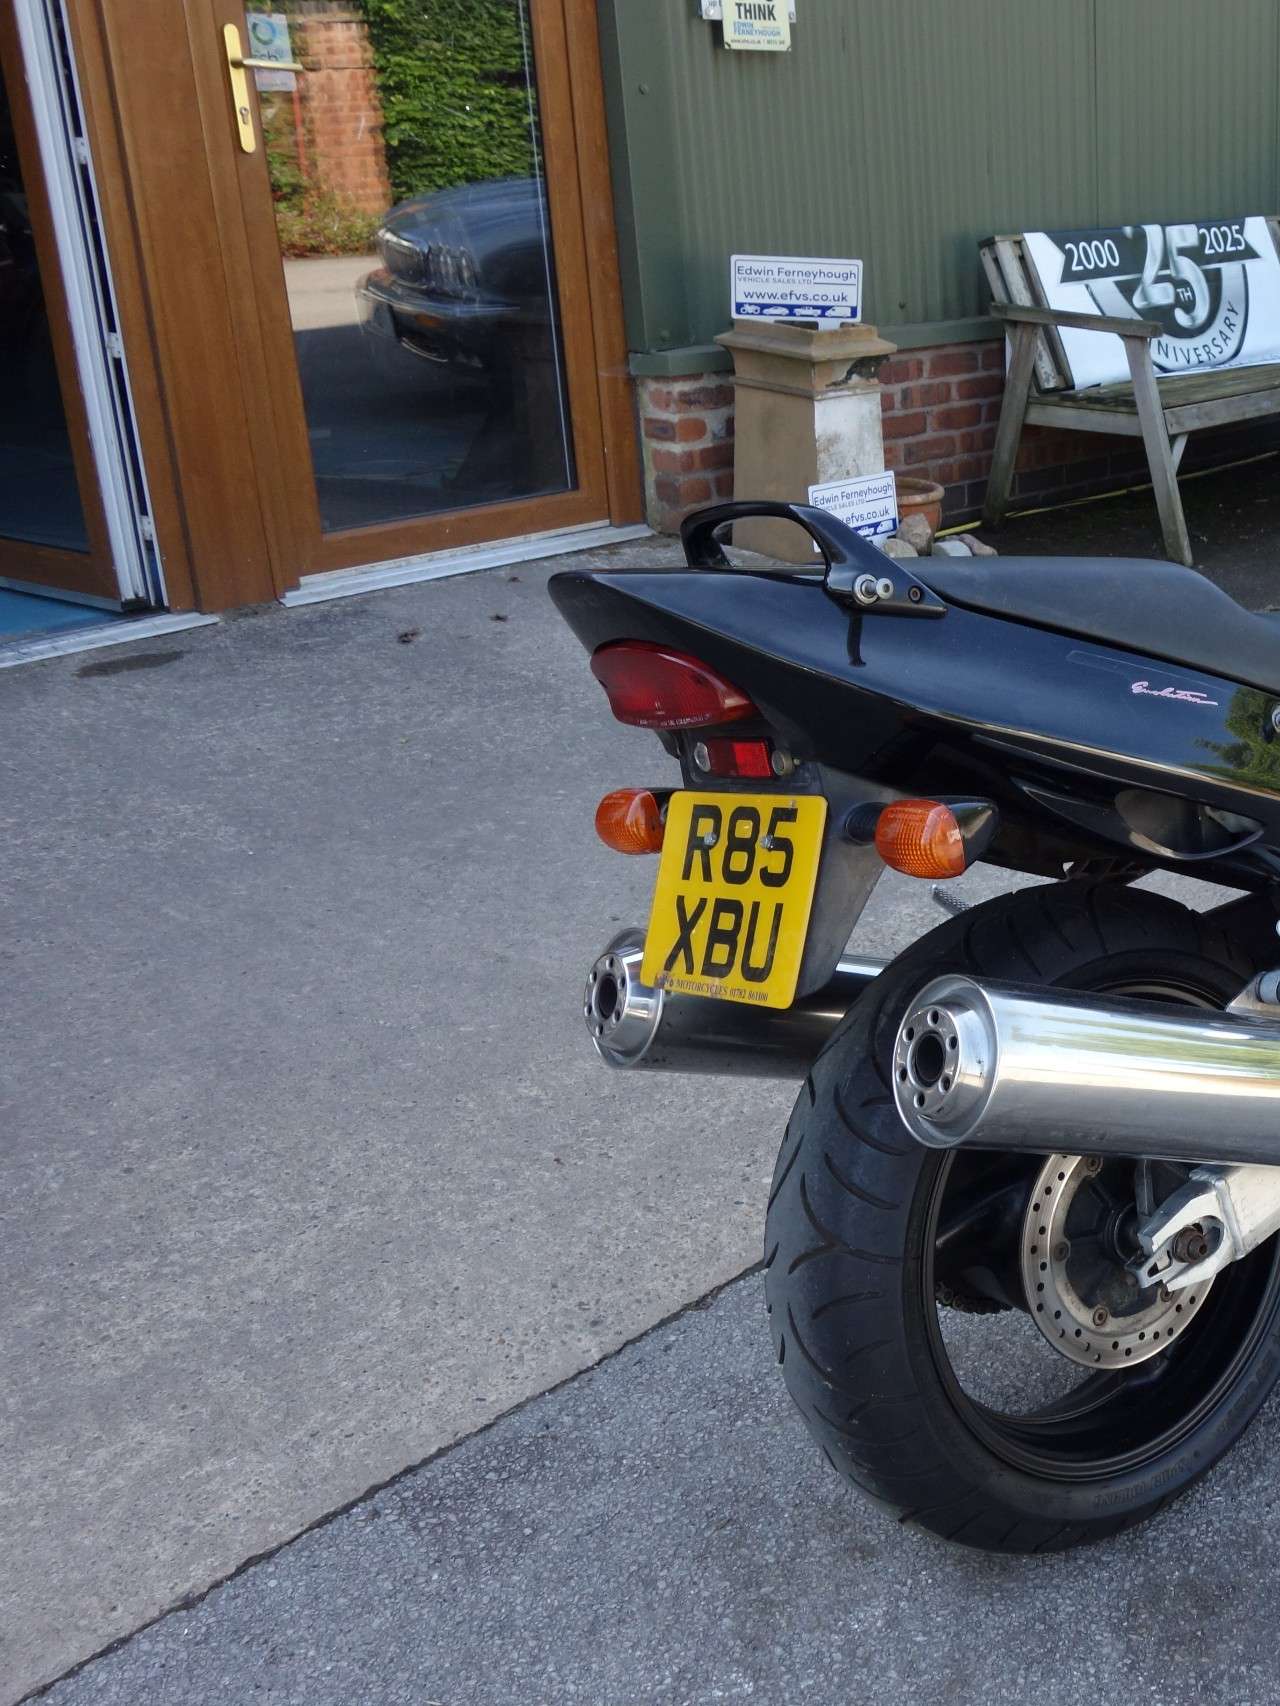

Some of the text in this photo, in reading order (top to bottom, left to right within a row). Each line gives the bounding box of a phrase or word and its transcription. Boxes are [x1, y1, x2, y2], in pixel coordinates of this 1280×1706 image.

[735, 3, 777, 21] THINK
[734, 28, 781, 37] FERNEYHOUGH
[1199, 224, 1246, 255] 2025
[1064, 238, 1120, 272] 2000
[737, 265, 857, 282] Edwin Ferneyhough
[738, 276, 769, 284] VEHICLE
[772, 277, 797, 285] SALES
[1123, 223, 1210, 329] 25
[743, 290, 849, 303] www.efvs.co.uk
[1176, 287, 1193, 301] TH
[1156, 300, 1239, 365] NIVERSARY
[814, 483, 893, 507] Edwin Ferneyhough
[681, 804, 798, 888] R85
[663, 895, 784, 983] XBU
